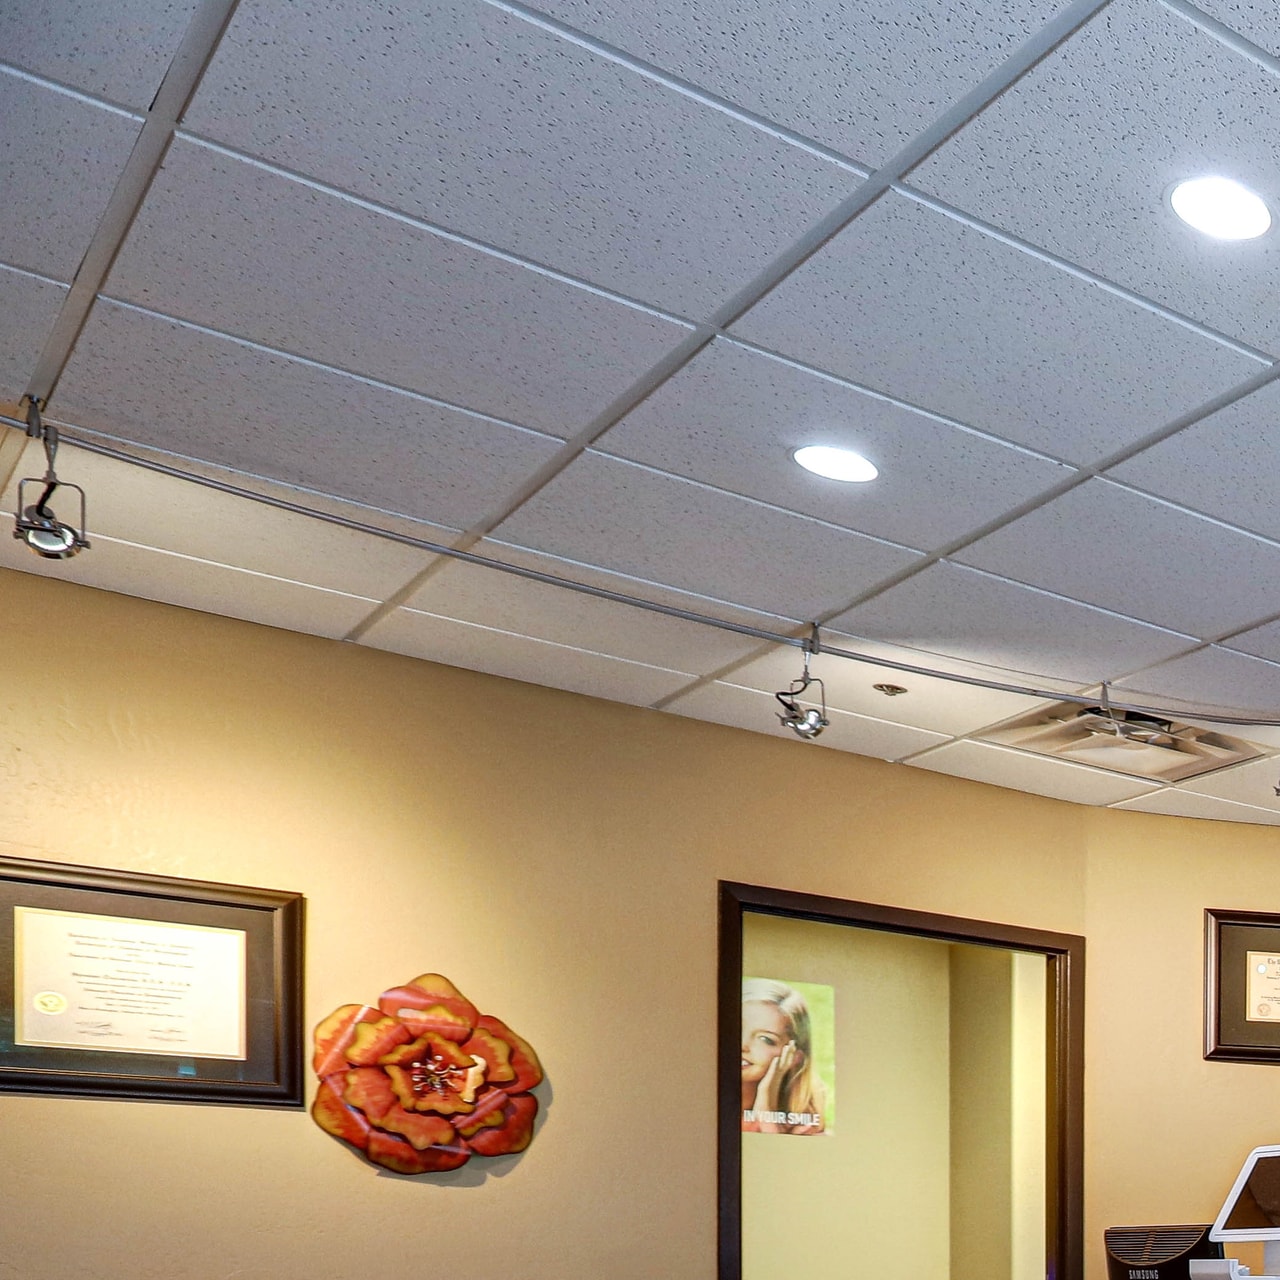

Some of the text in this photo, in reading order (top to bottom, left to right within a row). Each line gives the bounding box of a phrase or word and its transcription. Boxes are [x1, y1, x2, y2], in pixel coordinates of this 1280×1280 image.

[743, 1110, 755, 1122] IN
[788, 1112, 820, 1126] SMILE
[1129, 1269, 1159, 1280] SAMSUNG
